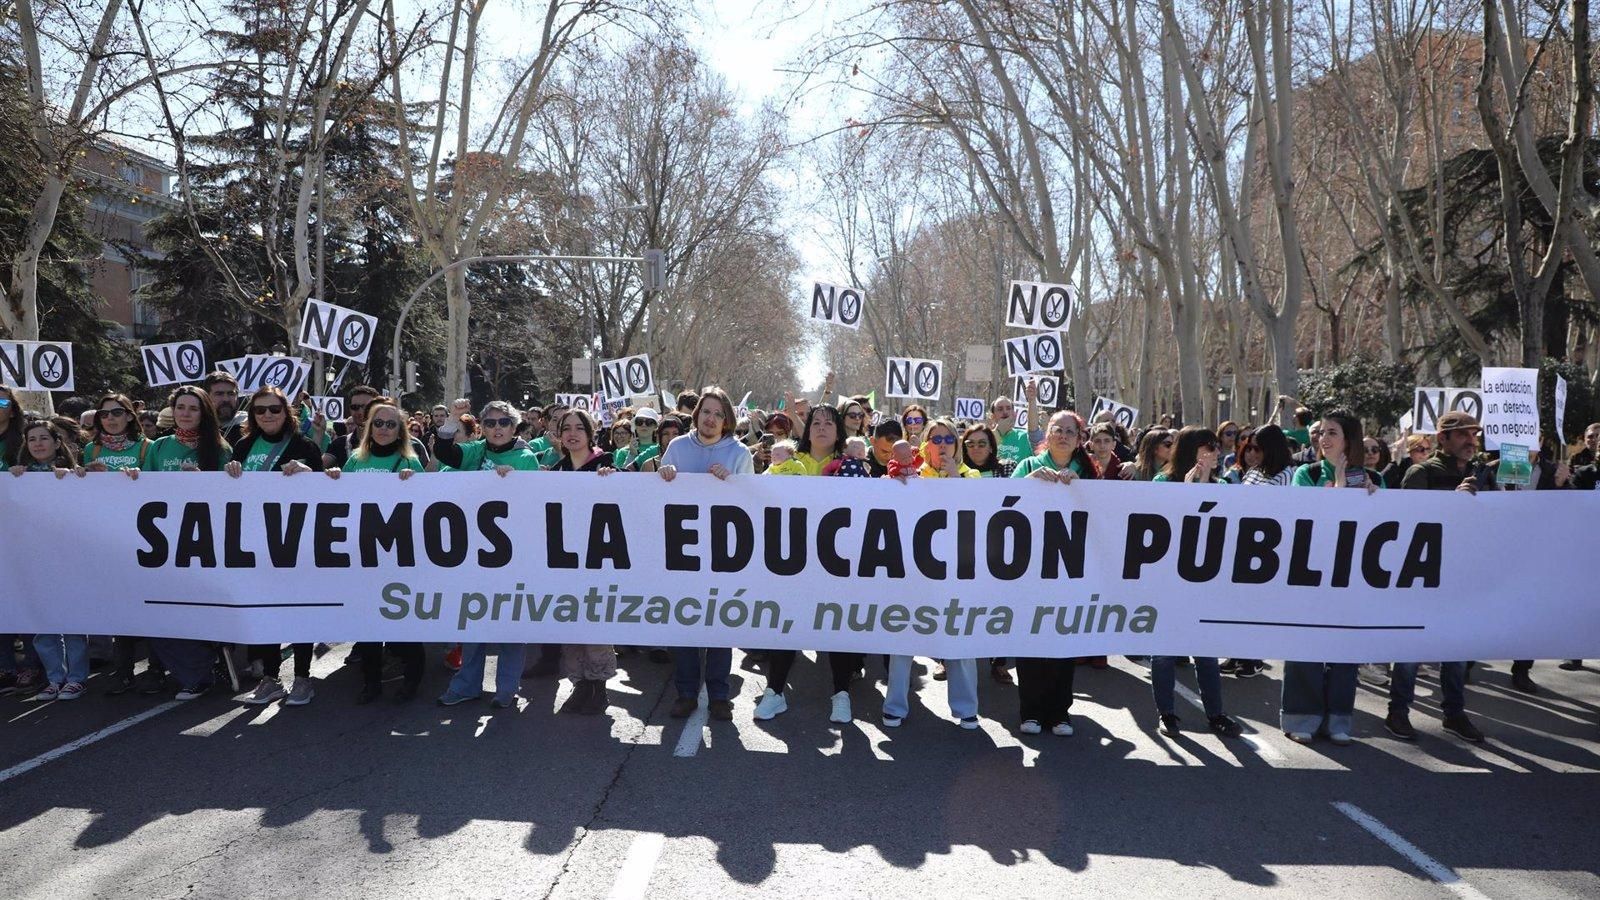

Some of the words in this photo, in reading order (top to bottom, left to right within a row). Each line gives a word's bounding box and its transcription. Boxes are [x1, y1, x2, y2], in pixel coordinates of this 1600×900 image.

[811, 283, 861, 325] NO
[1009, 284, 1070, 328] NO
[302, 302, 370, 357] NO
[0, 344, 69, 389] NO
[144, 343, 203, 384] NO
[1007, 335, 1060, 374] NO
[601, 357, 650, 399] NO
[888, 360, 939, 397] NO
[1483, 380, 1493, 393] La
[1495, 380, 1533, 397] educación,
[957, 400, 983, 418] NO
[1487, 403, 1499, 414] un
[1503, 400, 1533, 416] derecho,
[1486, 423, 1499, 435] no
[1502, 421, 1536, 437] negocio!
[136, 501, 512, 569] SALVEMOS
[545, 502, 631, 570] LA
[664, 496, 1088, 581] EDUCACIÓN
[1122, 501, 1442, 589] PÚBLICA
[379, 582, 443, 621] Su
[457, 583, 795, 635] privatización,
[813, 599, 1013, 636] nuestra
[1030, 594, 1159, 635] ruina
